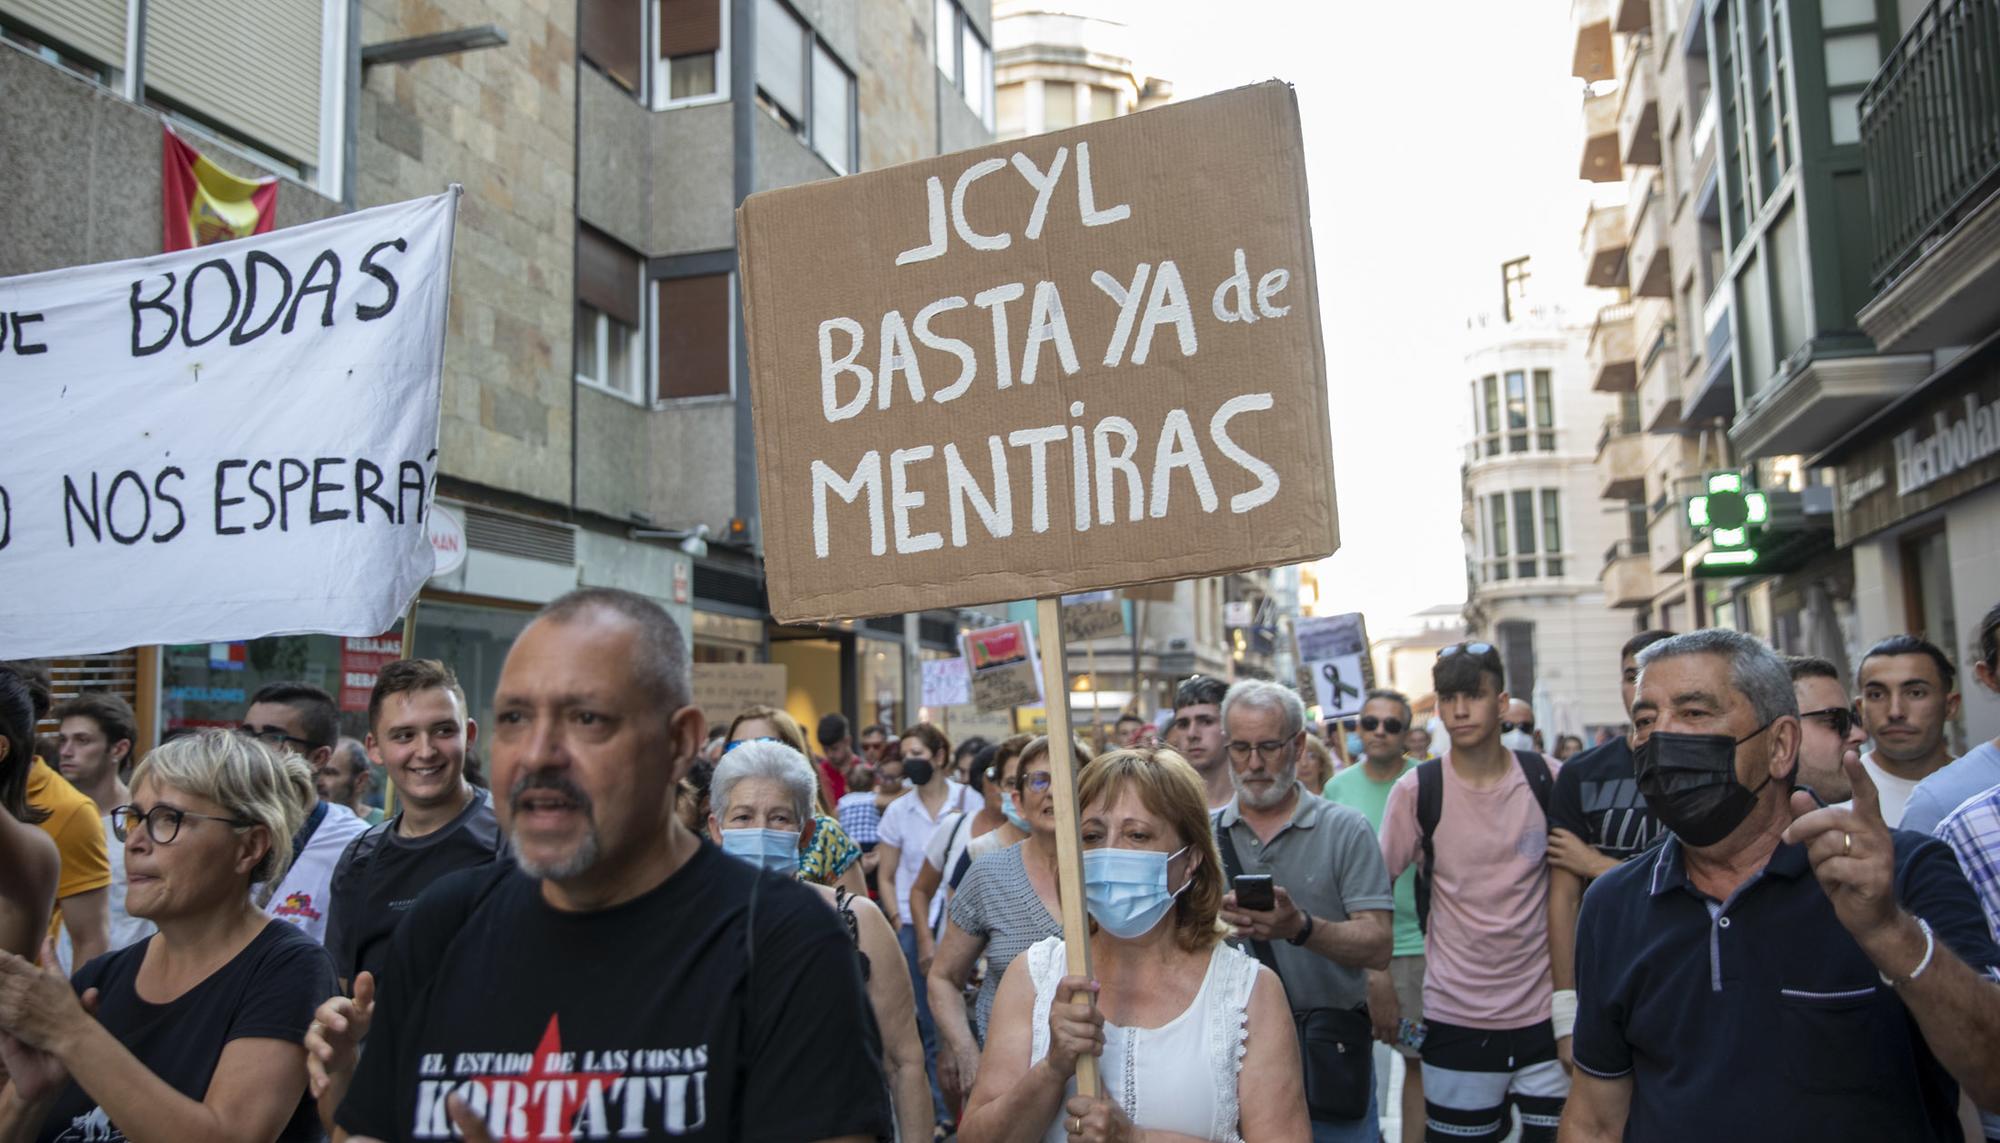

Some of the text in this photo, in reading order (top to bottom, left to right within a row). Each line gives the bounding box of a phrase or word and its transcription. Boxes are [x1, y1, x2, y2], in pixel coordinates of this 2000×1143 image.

[896, 141, 1131, 265] JCYL
[130, 237, 408, 357] BODAS
[817, 248, 1291, 422] BASTA YA de
[64, 466, 186, 547] NOS
[346, 637, 402, 656] REBAJAS
[346, 672, 378, 689] REBA
[419, 1044, 708, 1074] EL ESTADO DE LAS COSAS
[412, 1071, 708, 1142] KORTATU
